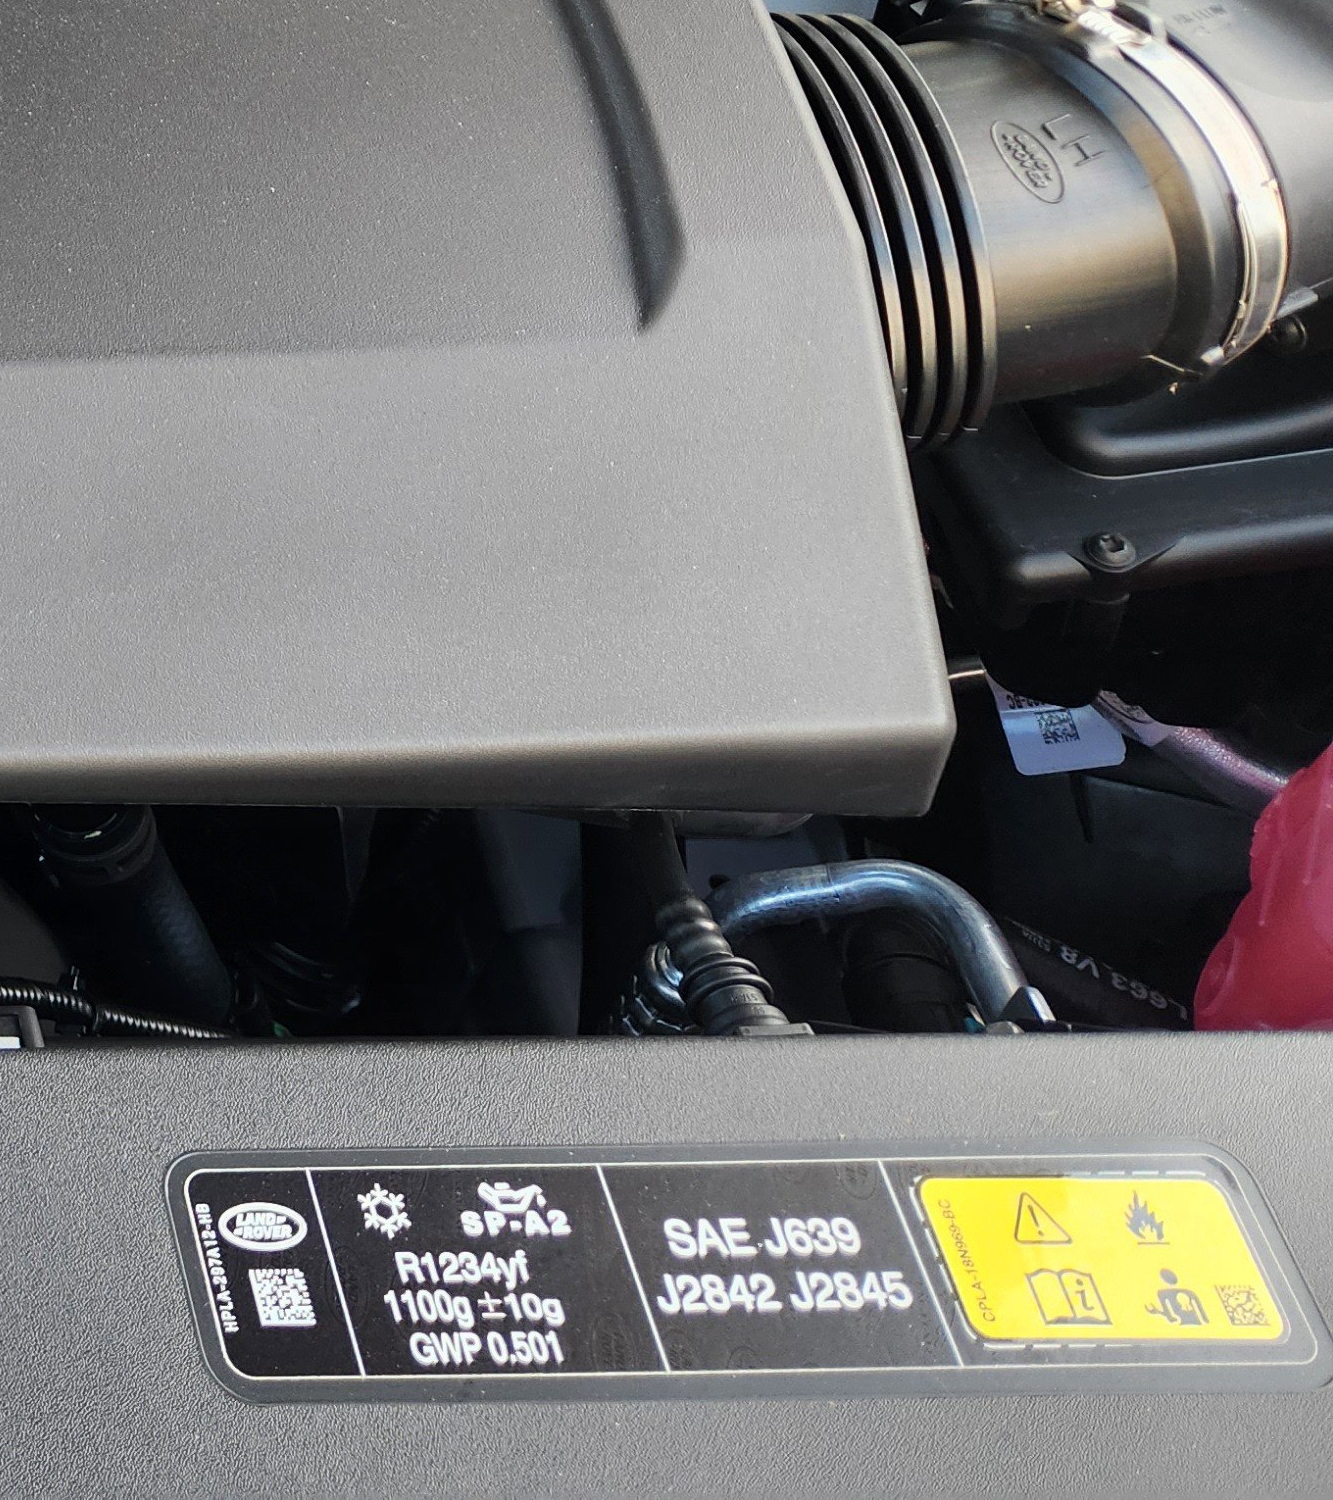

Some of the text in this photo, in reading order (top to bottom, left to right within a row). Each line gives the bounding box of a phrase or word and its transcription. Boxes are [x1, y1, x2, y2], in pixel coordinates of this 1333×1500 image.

[1041, 113, 1107, 167] LH
[235, 1212, 277, 1227] LAND
[242, 1224, 293, 1240] ROVER
[459, 1209, 572, 1238] SP-A2
[663, 1216, 862, 1260] SAE J639
[194, 1202, 240, 1334] HPLA-297A12-HB
[394, 1250, 530, 1291] R1234yf
[937, 1198, 997, 1323] CPLA-18N969-BC
[383, 1289, 475, 1330] 1100g
[656, 1270, 914, 1315] J2842 J2845
[409, 1330, 565, 1367] GWP 0.501
